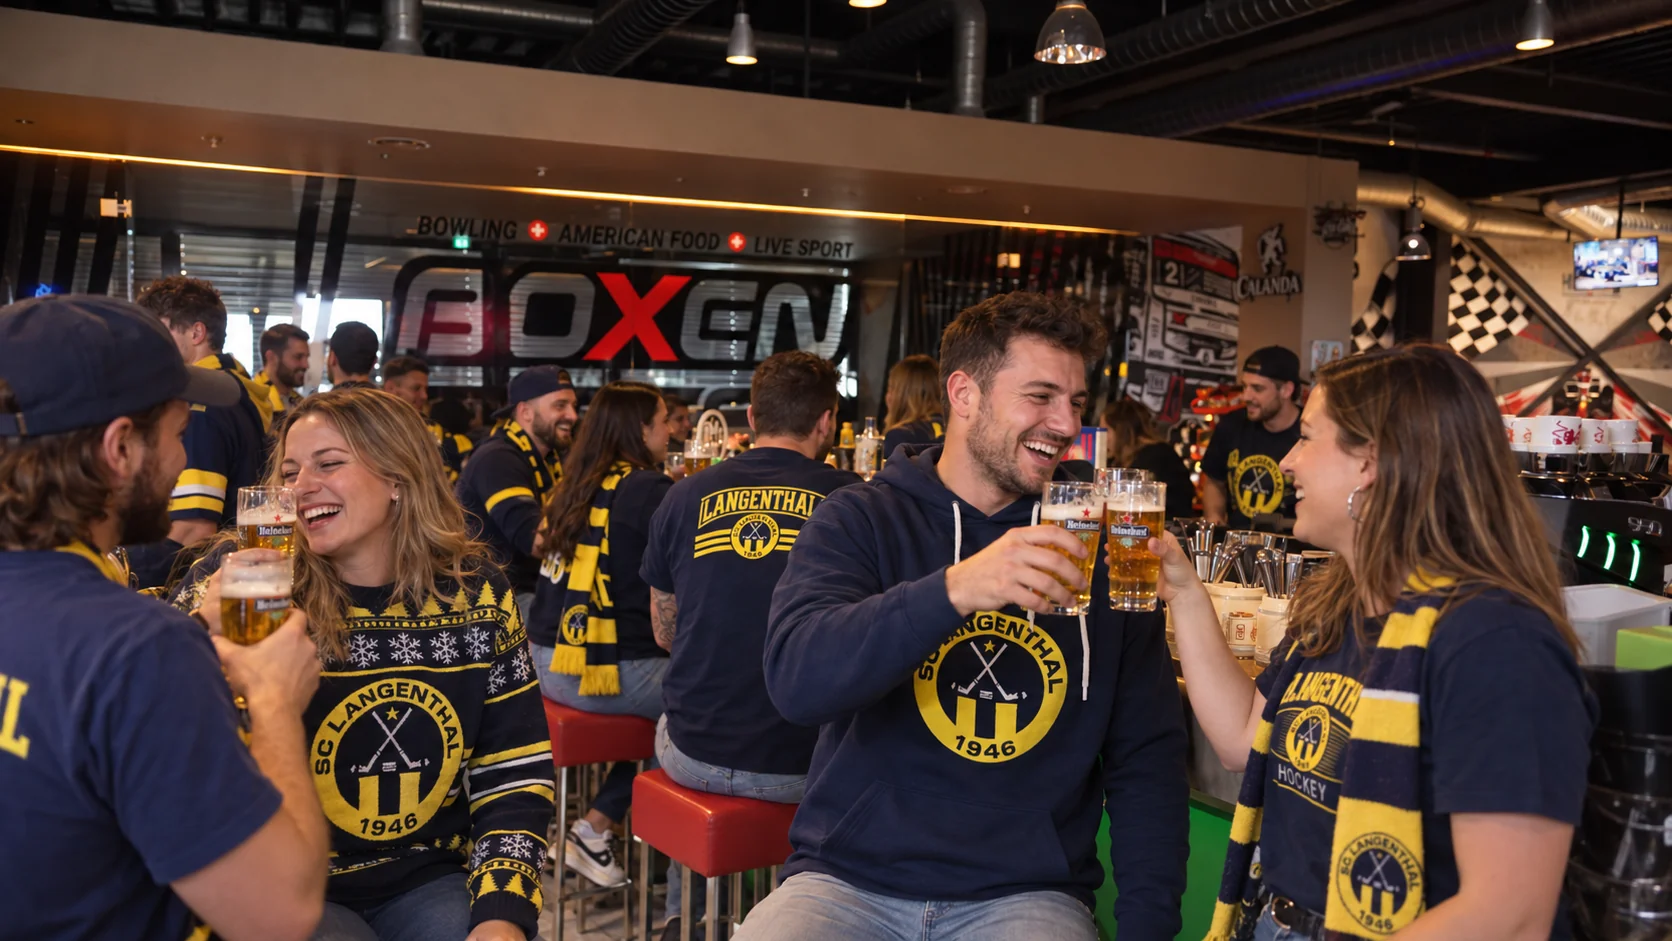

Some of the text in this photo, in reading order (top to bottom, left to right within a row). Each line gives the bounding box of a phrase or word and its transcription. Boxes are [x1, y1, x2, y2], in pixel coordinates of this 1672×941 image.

[417, 215, 855, 259] BOWLING AMERICAN FOOD LIVE SPORT
[1164, 261, 1179, 286] 2
[1236, 275, 1300, 300] CALANDA
[394, 266, 850, 362] BOXEN
[315, 682, 460, 776] SC LANGENTHAL
[955, 735, 1017, 759] 1946
[1278, 763, 1327, 802] HOCKEY
[360, 812, 418, 836] 1946
[1340, 836, 1420, 892] SC LANGENTHAL
[1359, 909, 1393, 930] 1946
